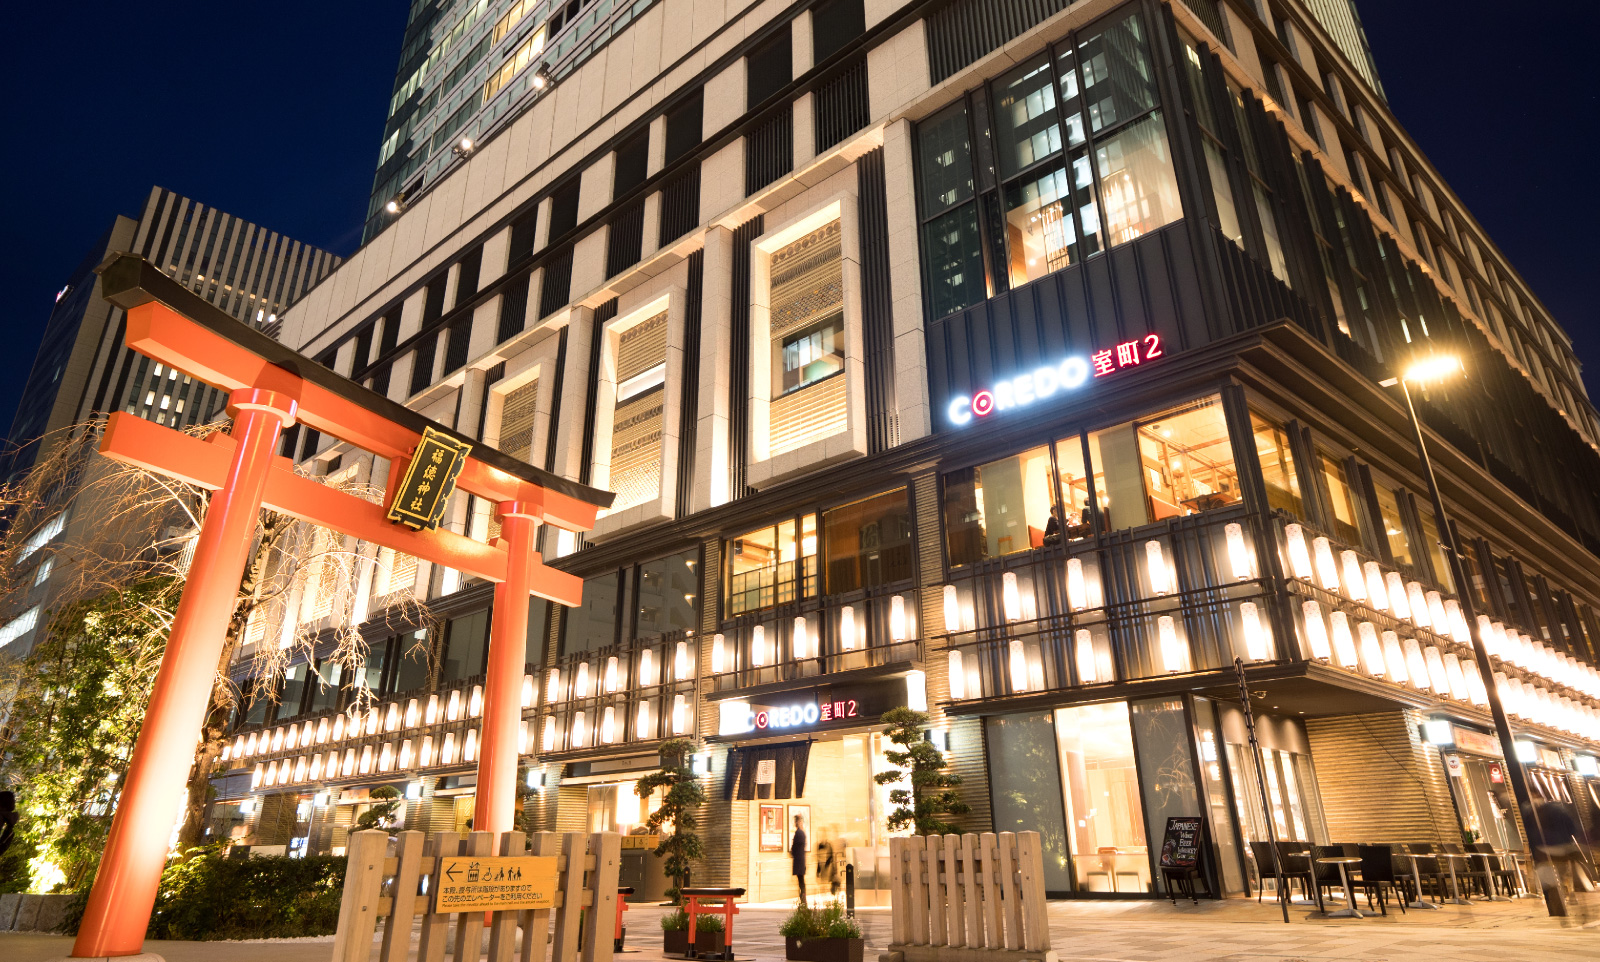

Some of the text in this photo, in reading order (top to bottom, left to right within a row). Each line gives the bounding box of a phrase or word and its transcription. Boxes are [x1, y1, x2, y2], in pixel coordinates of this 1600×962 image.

[948, 334, 1162, 426] COREDO 室町2
[410, 448, 445, 512] 福徳神社
[746, 700, 857, 730] COREDO 室町2
[1169, 820, 1198, 830] JAPANESE
